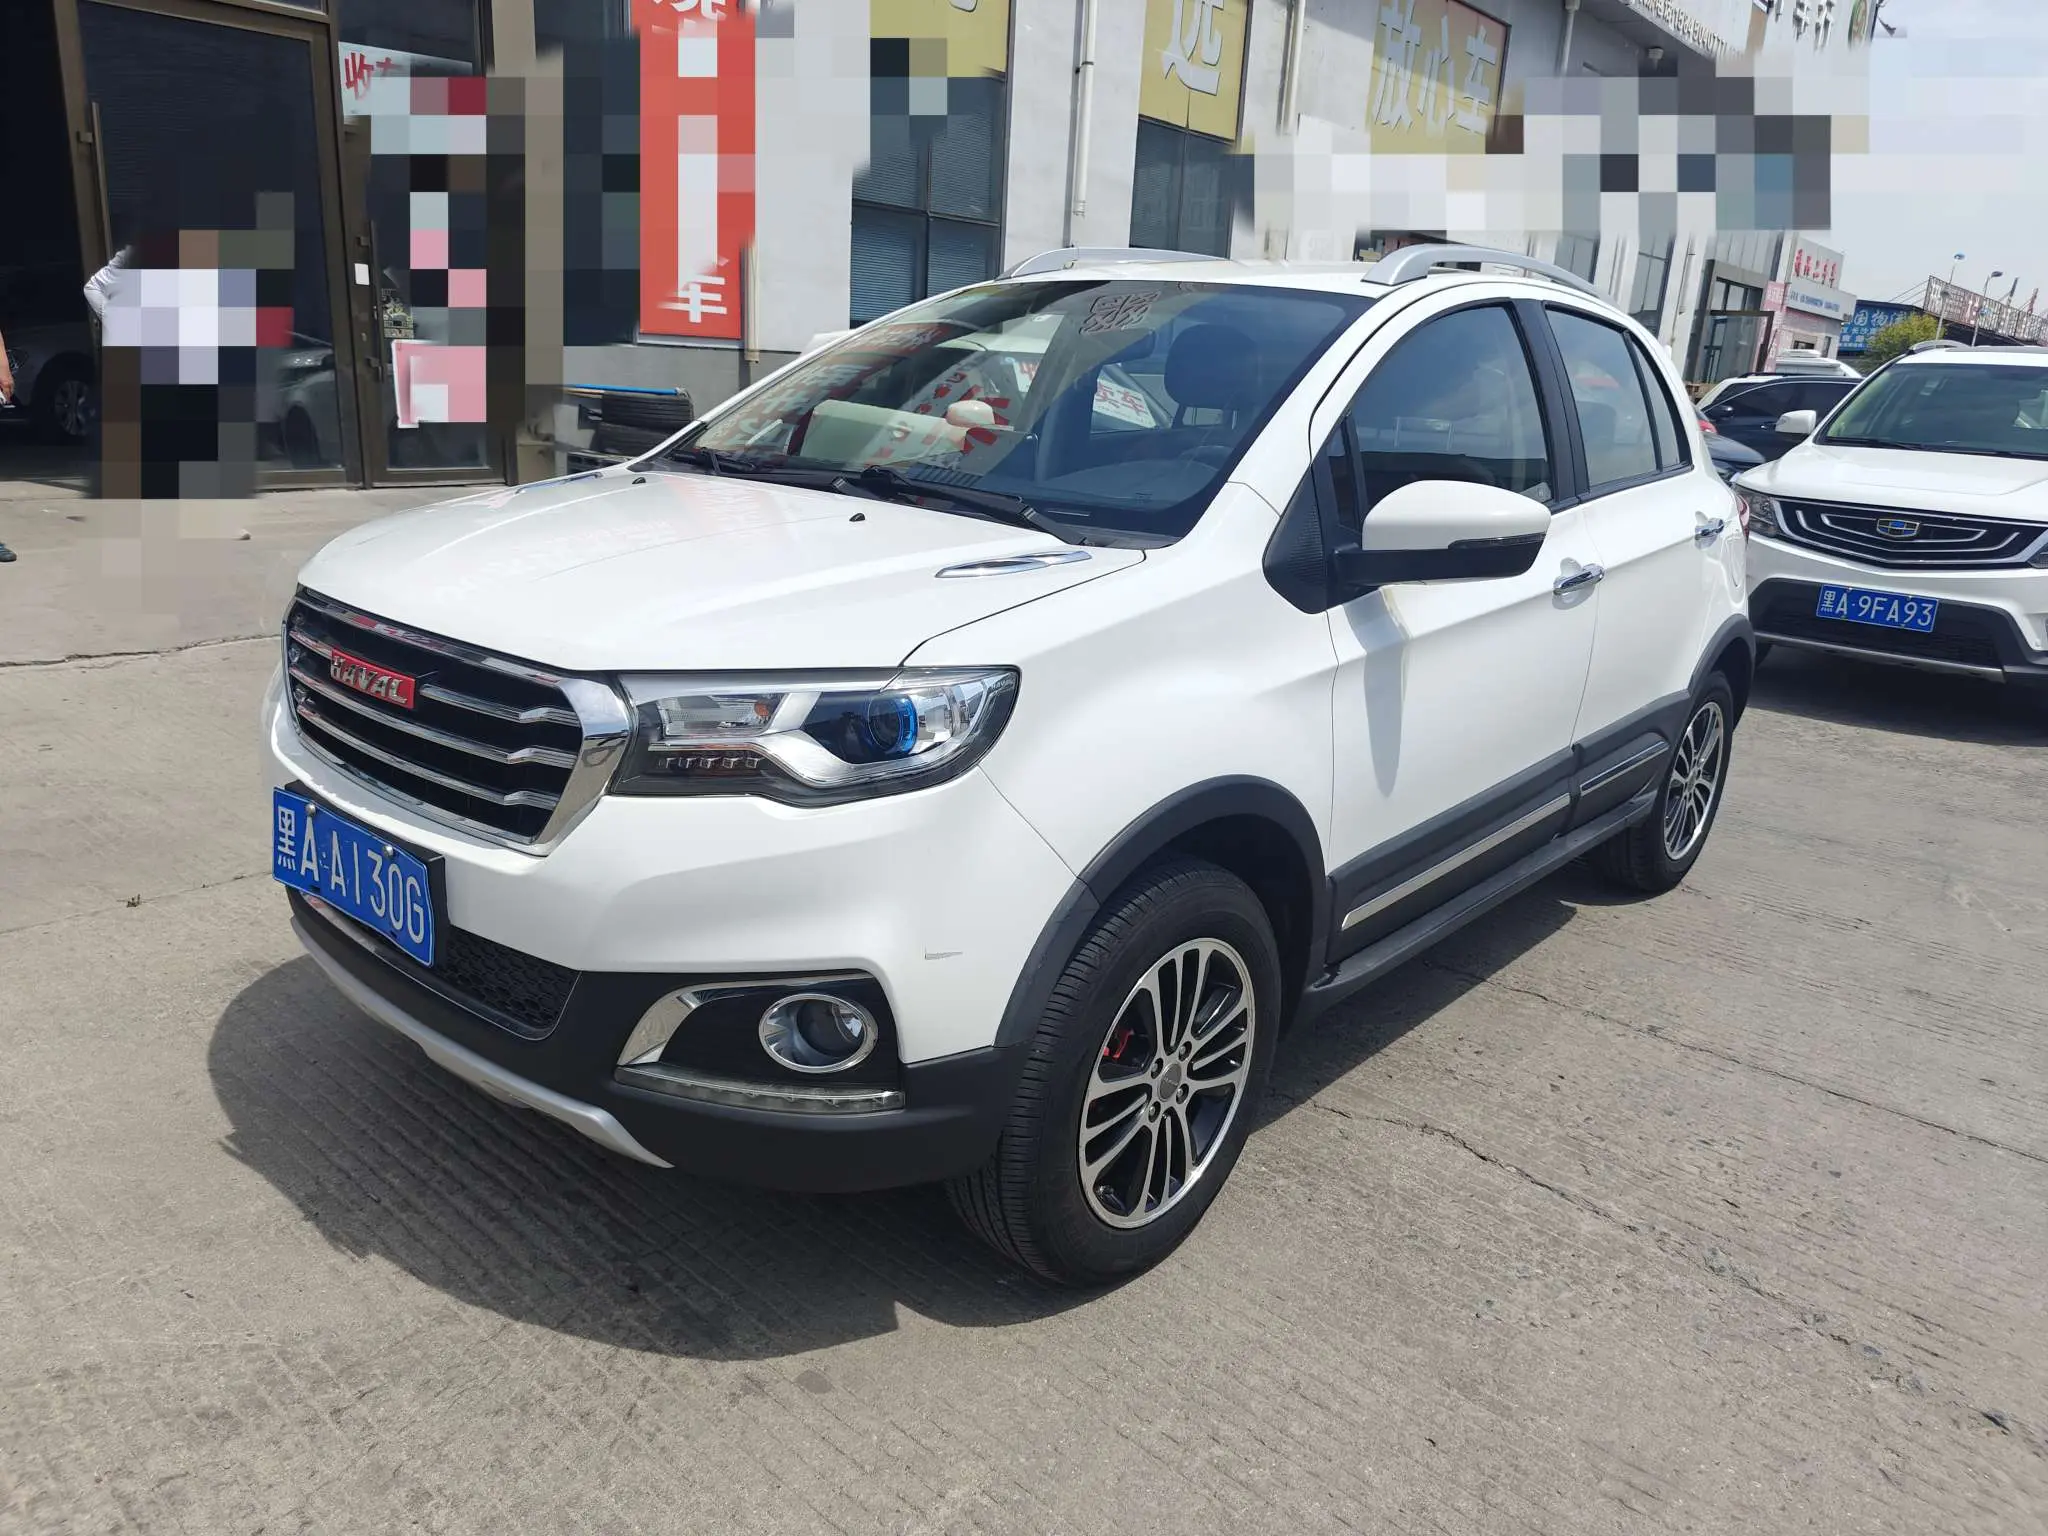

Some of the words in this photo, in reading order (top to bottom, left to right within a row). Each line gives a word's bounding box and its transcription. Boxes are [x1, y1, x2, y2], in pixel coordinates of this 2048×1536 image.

[1373, 0, 1497, 137] 放心车
[331, 655, 408, 704] HAVAL
